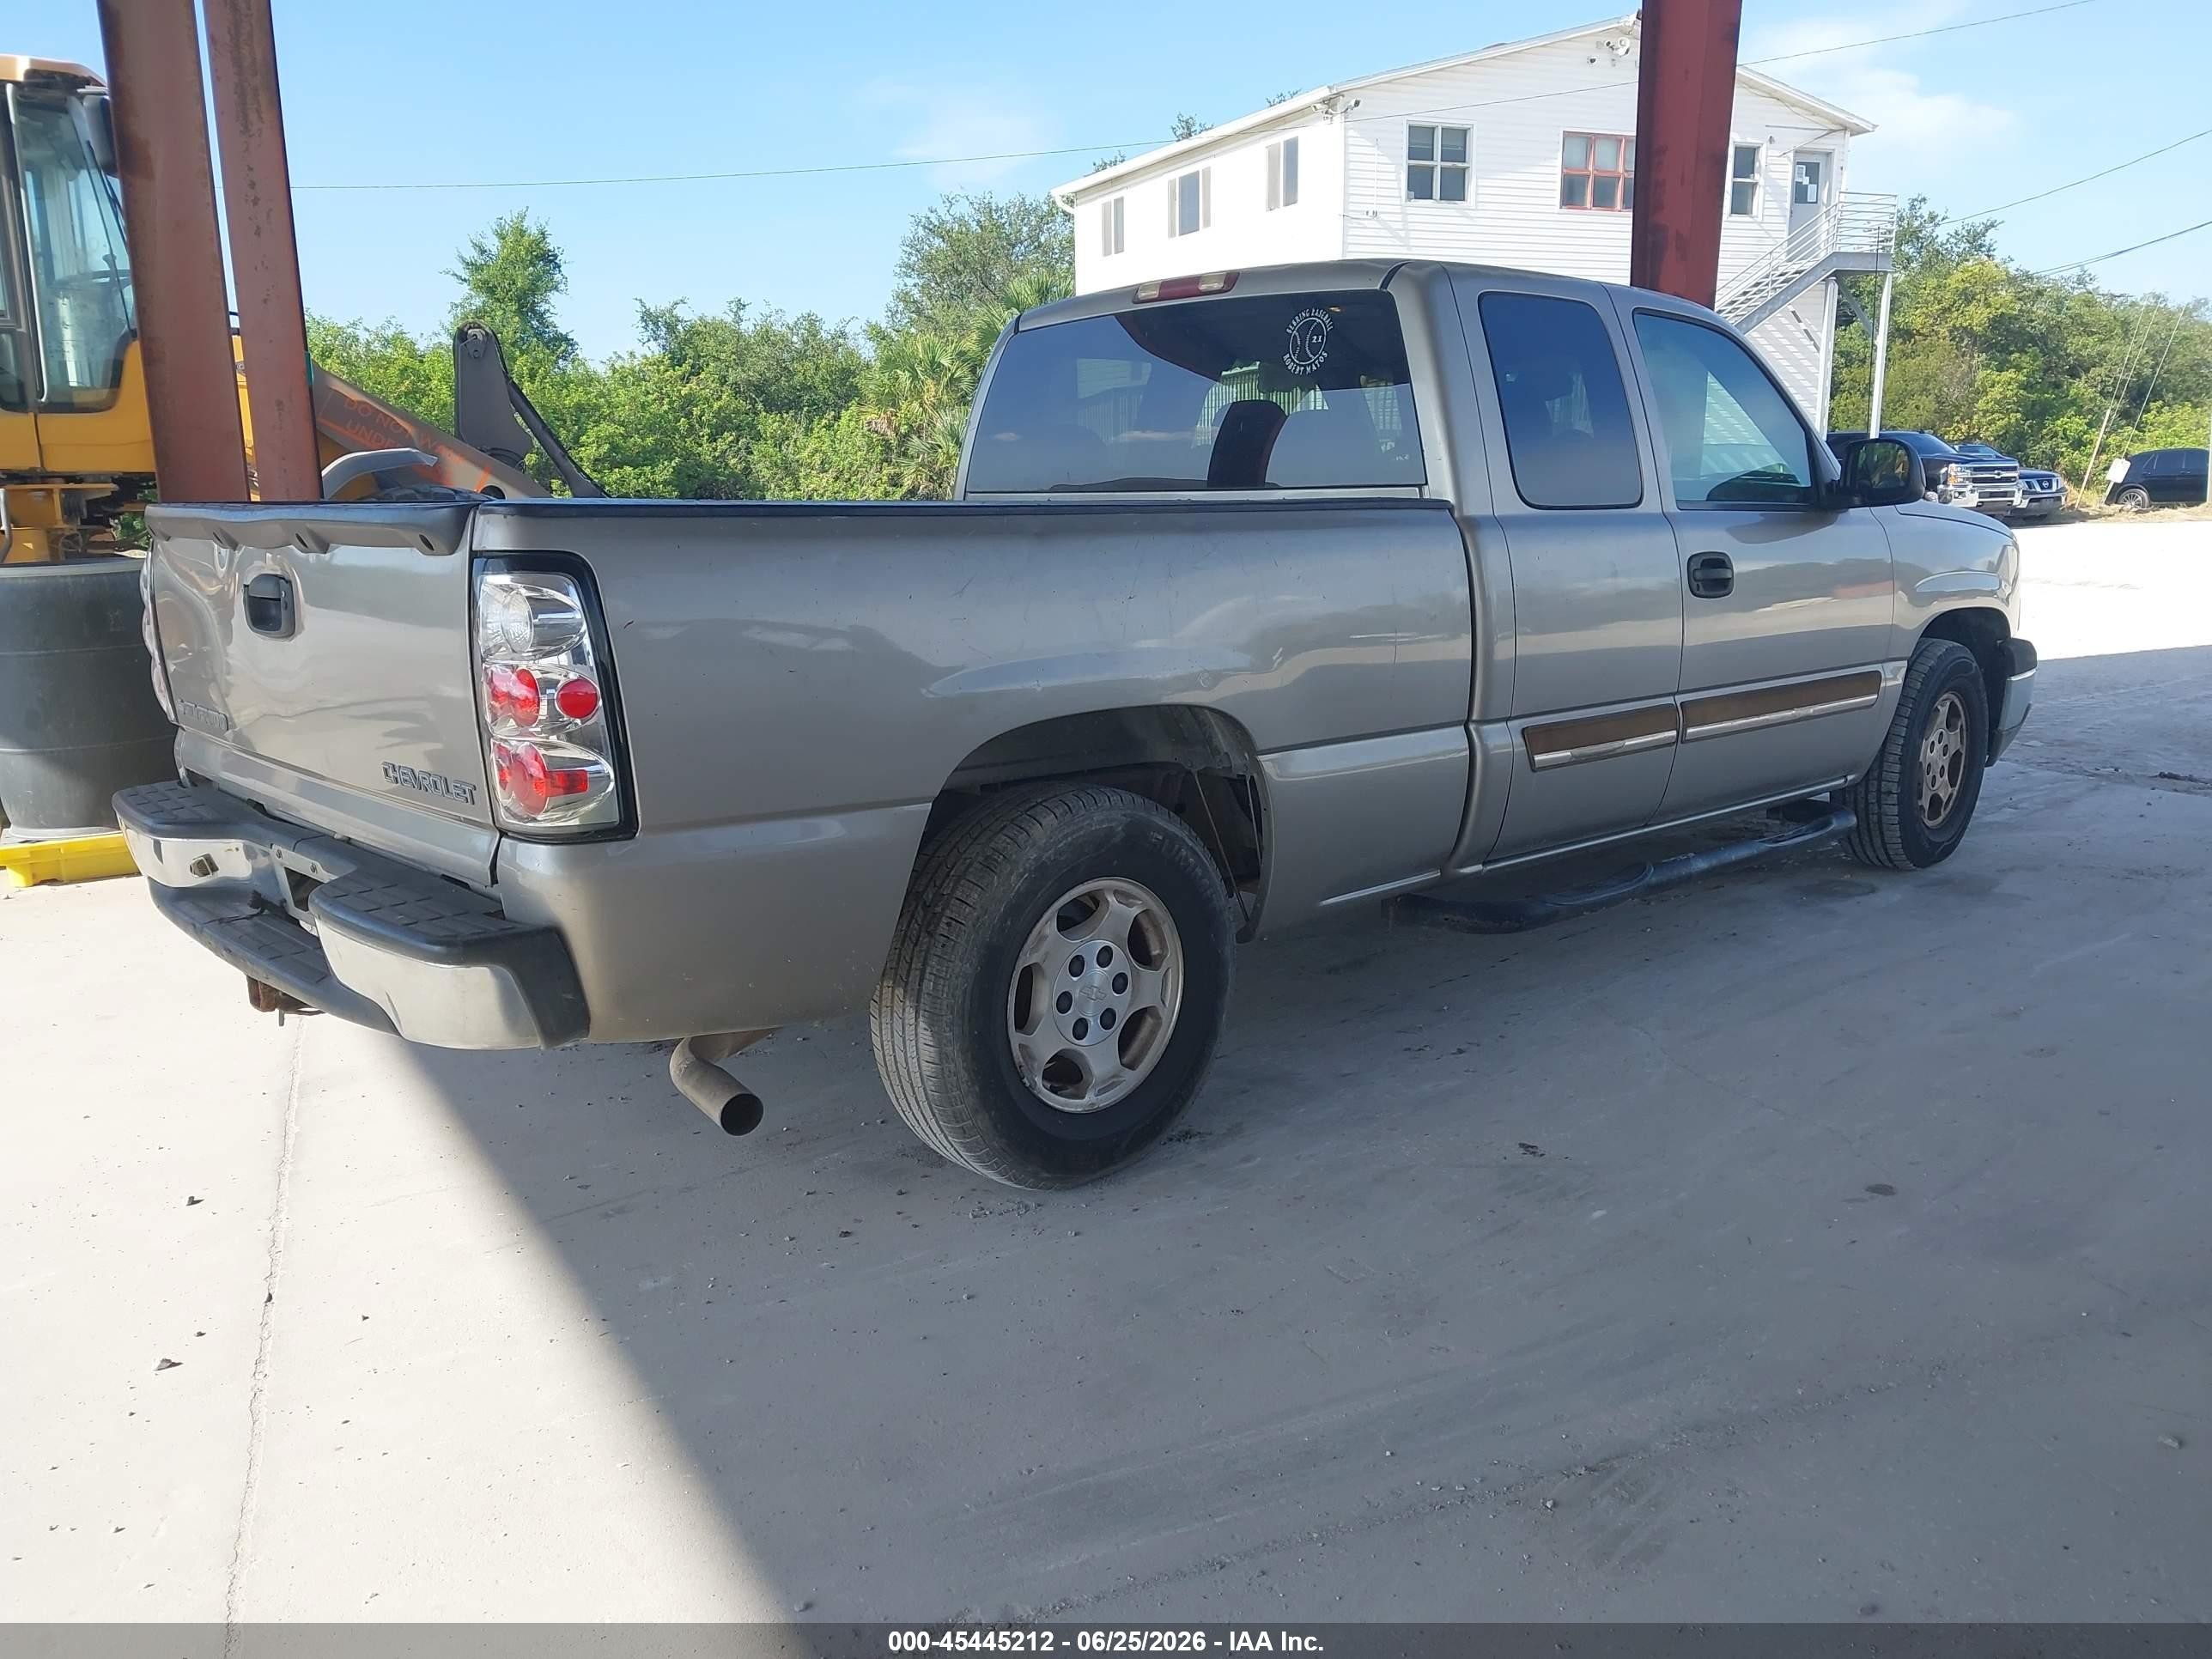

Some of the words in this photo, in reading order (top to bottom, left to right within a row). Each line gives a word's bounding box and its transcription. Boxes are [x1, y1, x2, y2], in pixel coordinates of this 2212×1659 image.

[1286, 308, 1310, 334] SEBRING
[1311, 335, 1322, 343] 21
[1283, 353, 1304, 374] ROBERT
[1306, 350, 1328, 374] MATOS
[381, 761, 477, 805] CHEVROLET
